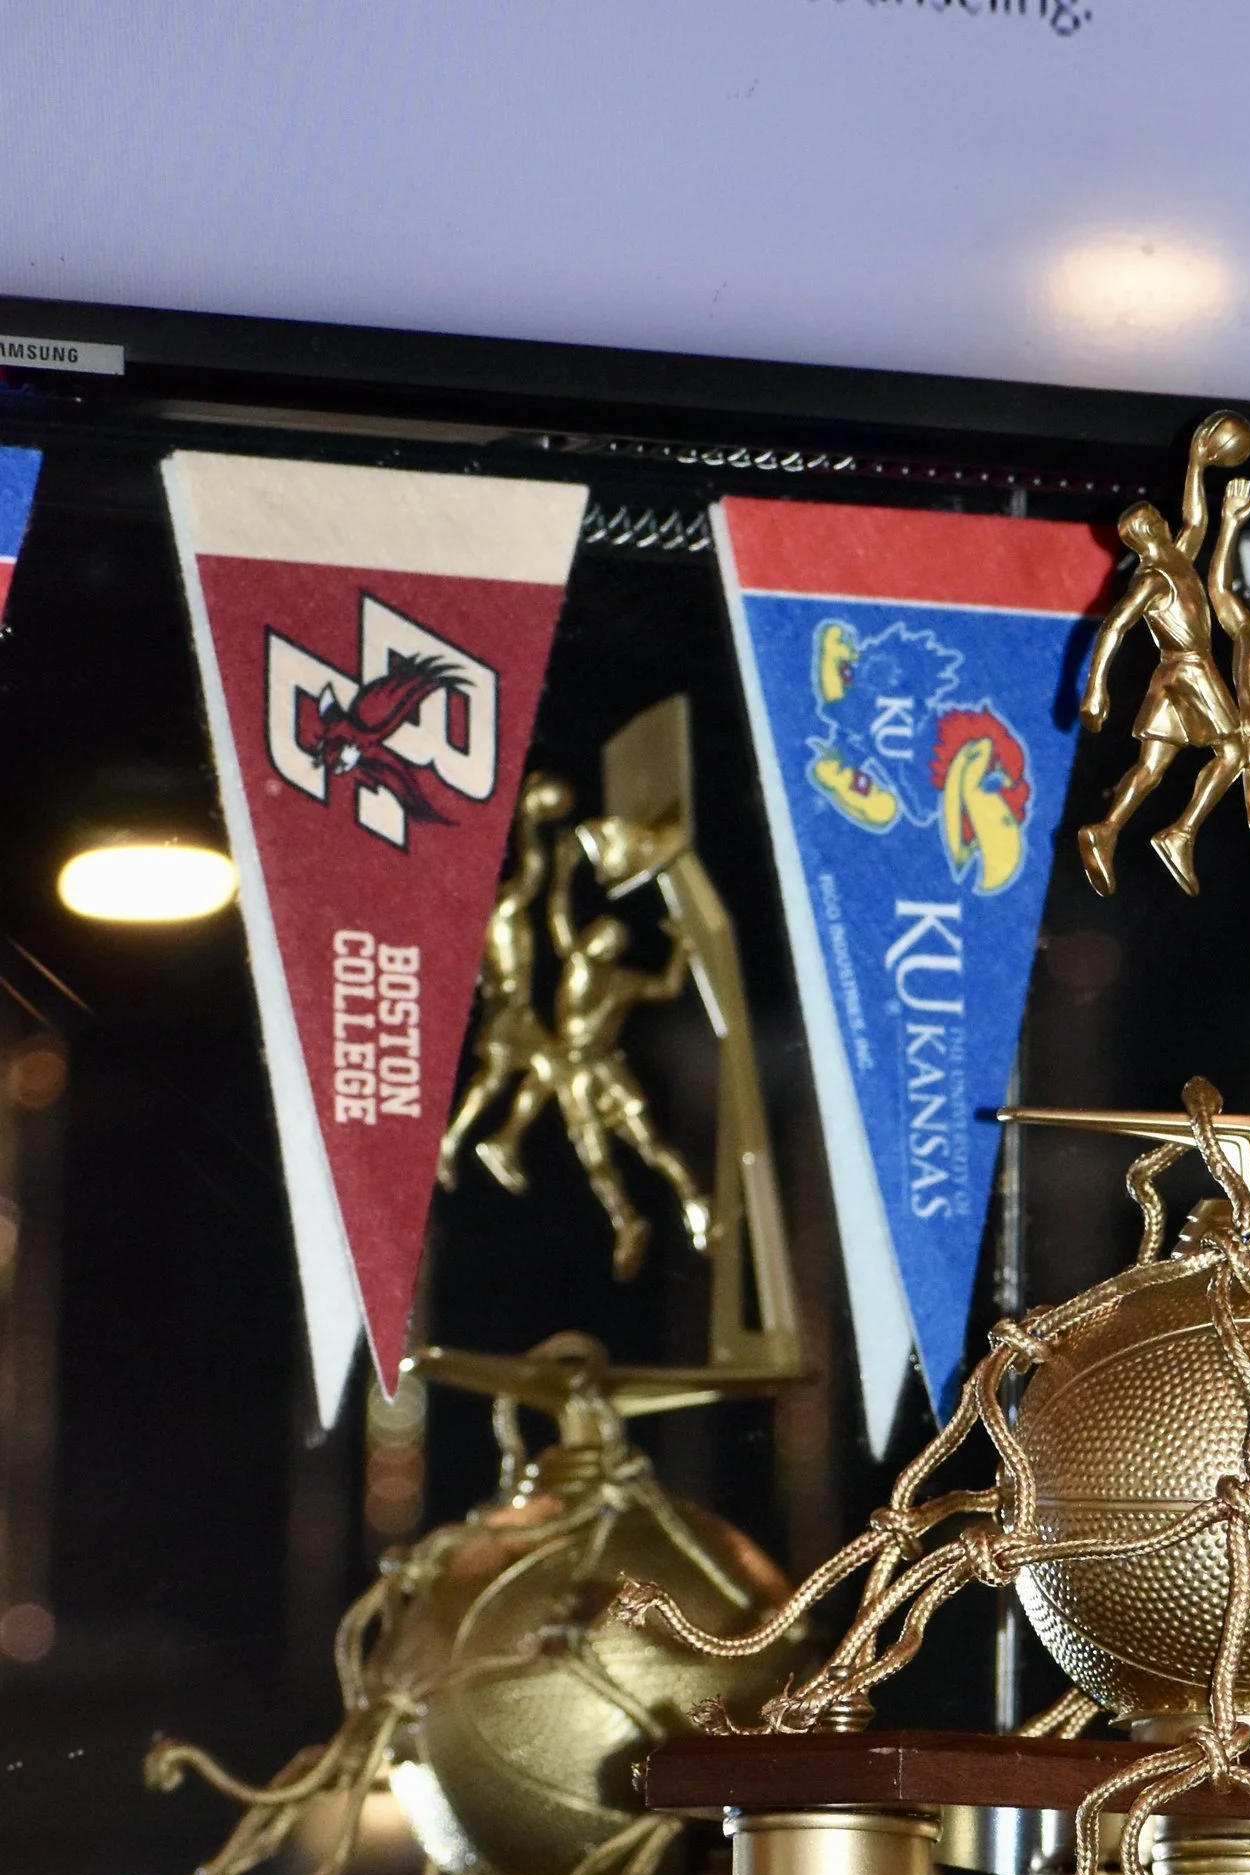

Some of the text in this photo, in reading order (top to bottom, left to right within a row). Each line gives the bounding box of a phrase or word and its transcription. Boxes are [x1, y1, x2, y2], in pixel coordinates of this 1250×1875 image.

[875, 695, 914, 760] KU
[333, 929, 377, 1125] COLLEGE
[379, 944, 421, 1119] BOSTON
[884, 899, 965, 1016] KU
[905, 1022, 951, 1220] KANSAS
